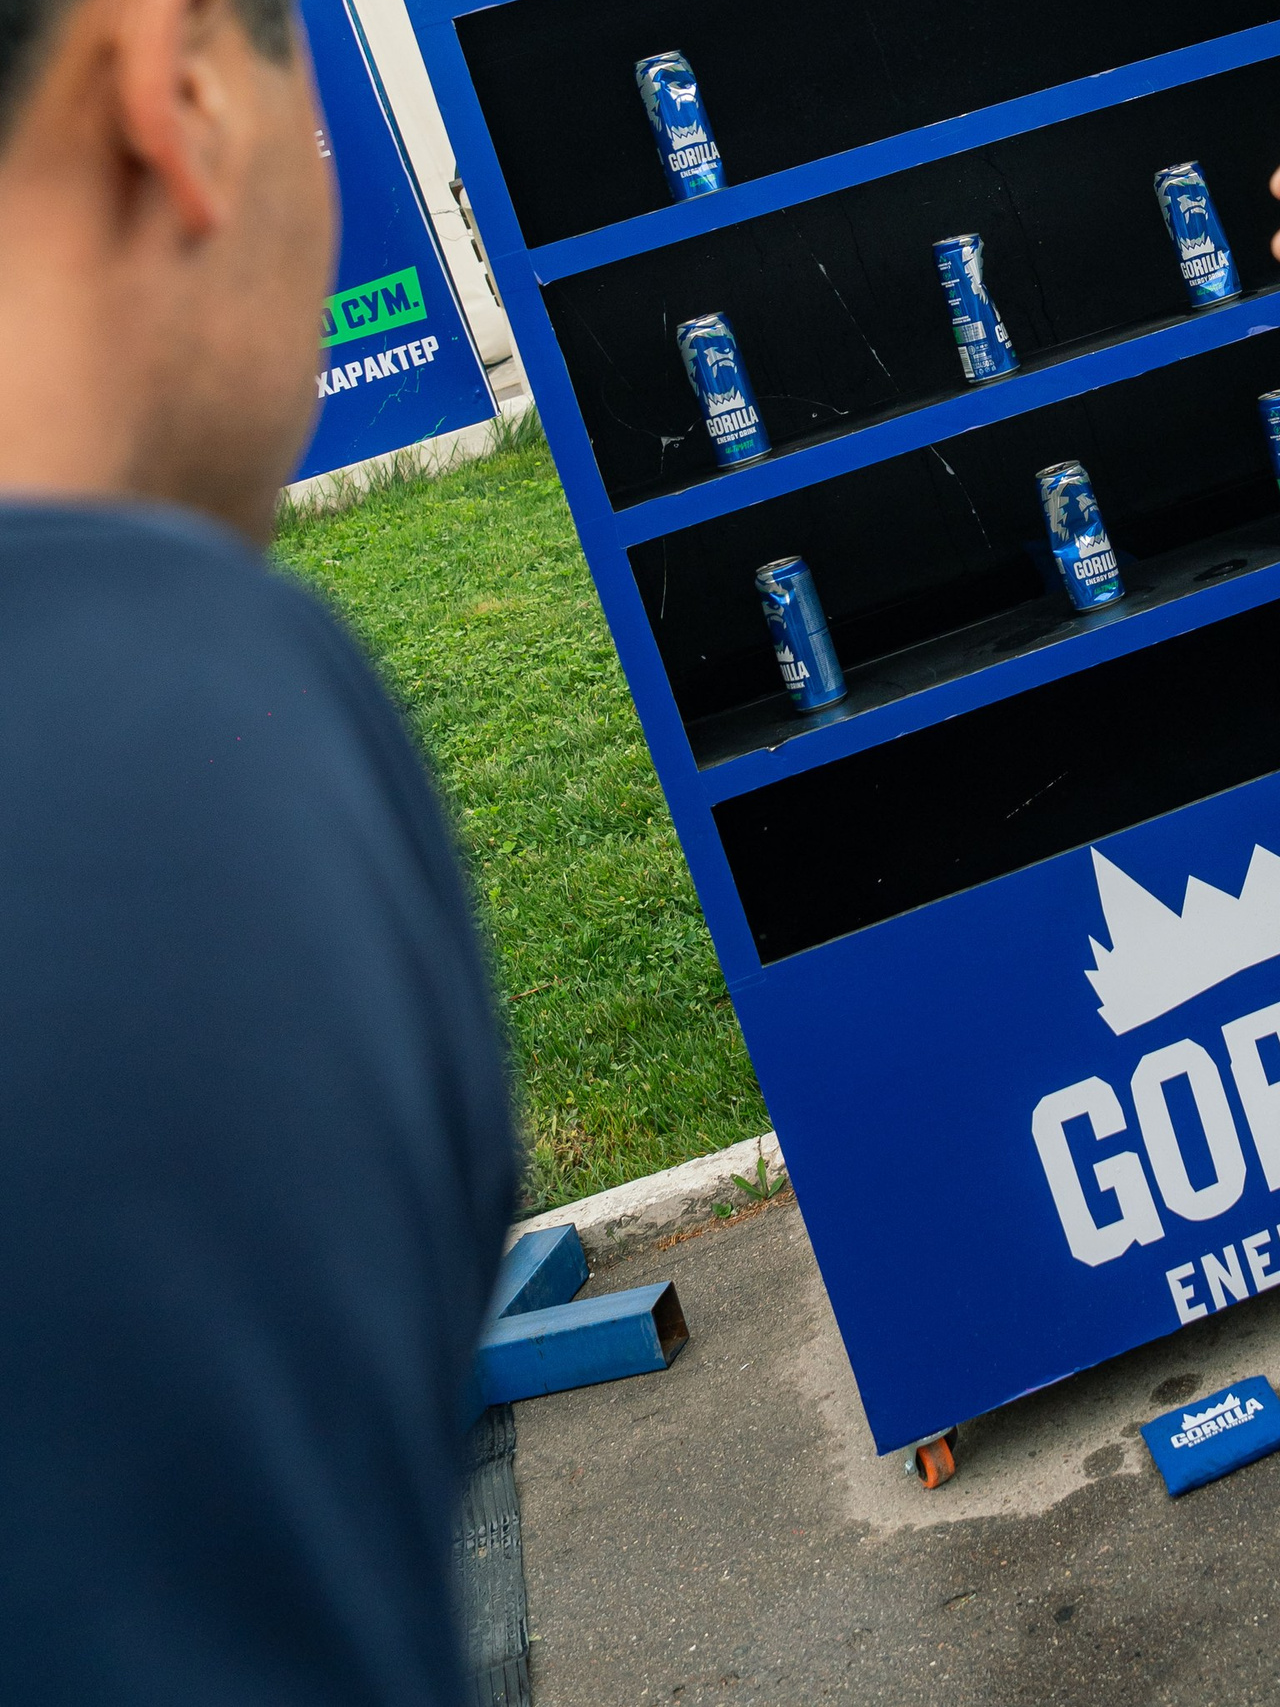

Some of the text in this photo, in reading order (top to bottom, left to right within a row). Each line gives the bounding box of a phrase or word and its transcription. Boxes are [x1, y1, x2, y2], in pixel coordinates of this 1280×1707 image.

[667, 141, 721, 172] GORILLA
[1180, 250, 1230, 280] GORILLA
[341, 282, 420, 330] СУМ.
[315, 335, 440, 399] ХАРАКТЕР
[706, 405, 759, 437] GORILLA
[716, 426, 757, 445] ENERGY DRINK
[1085, 573, 1107, 587] ENERGY
[1170, 1397, 1265, 1449] GORILLA
